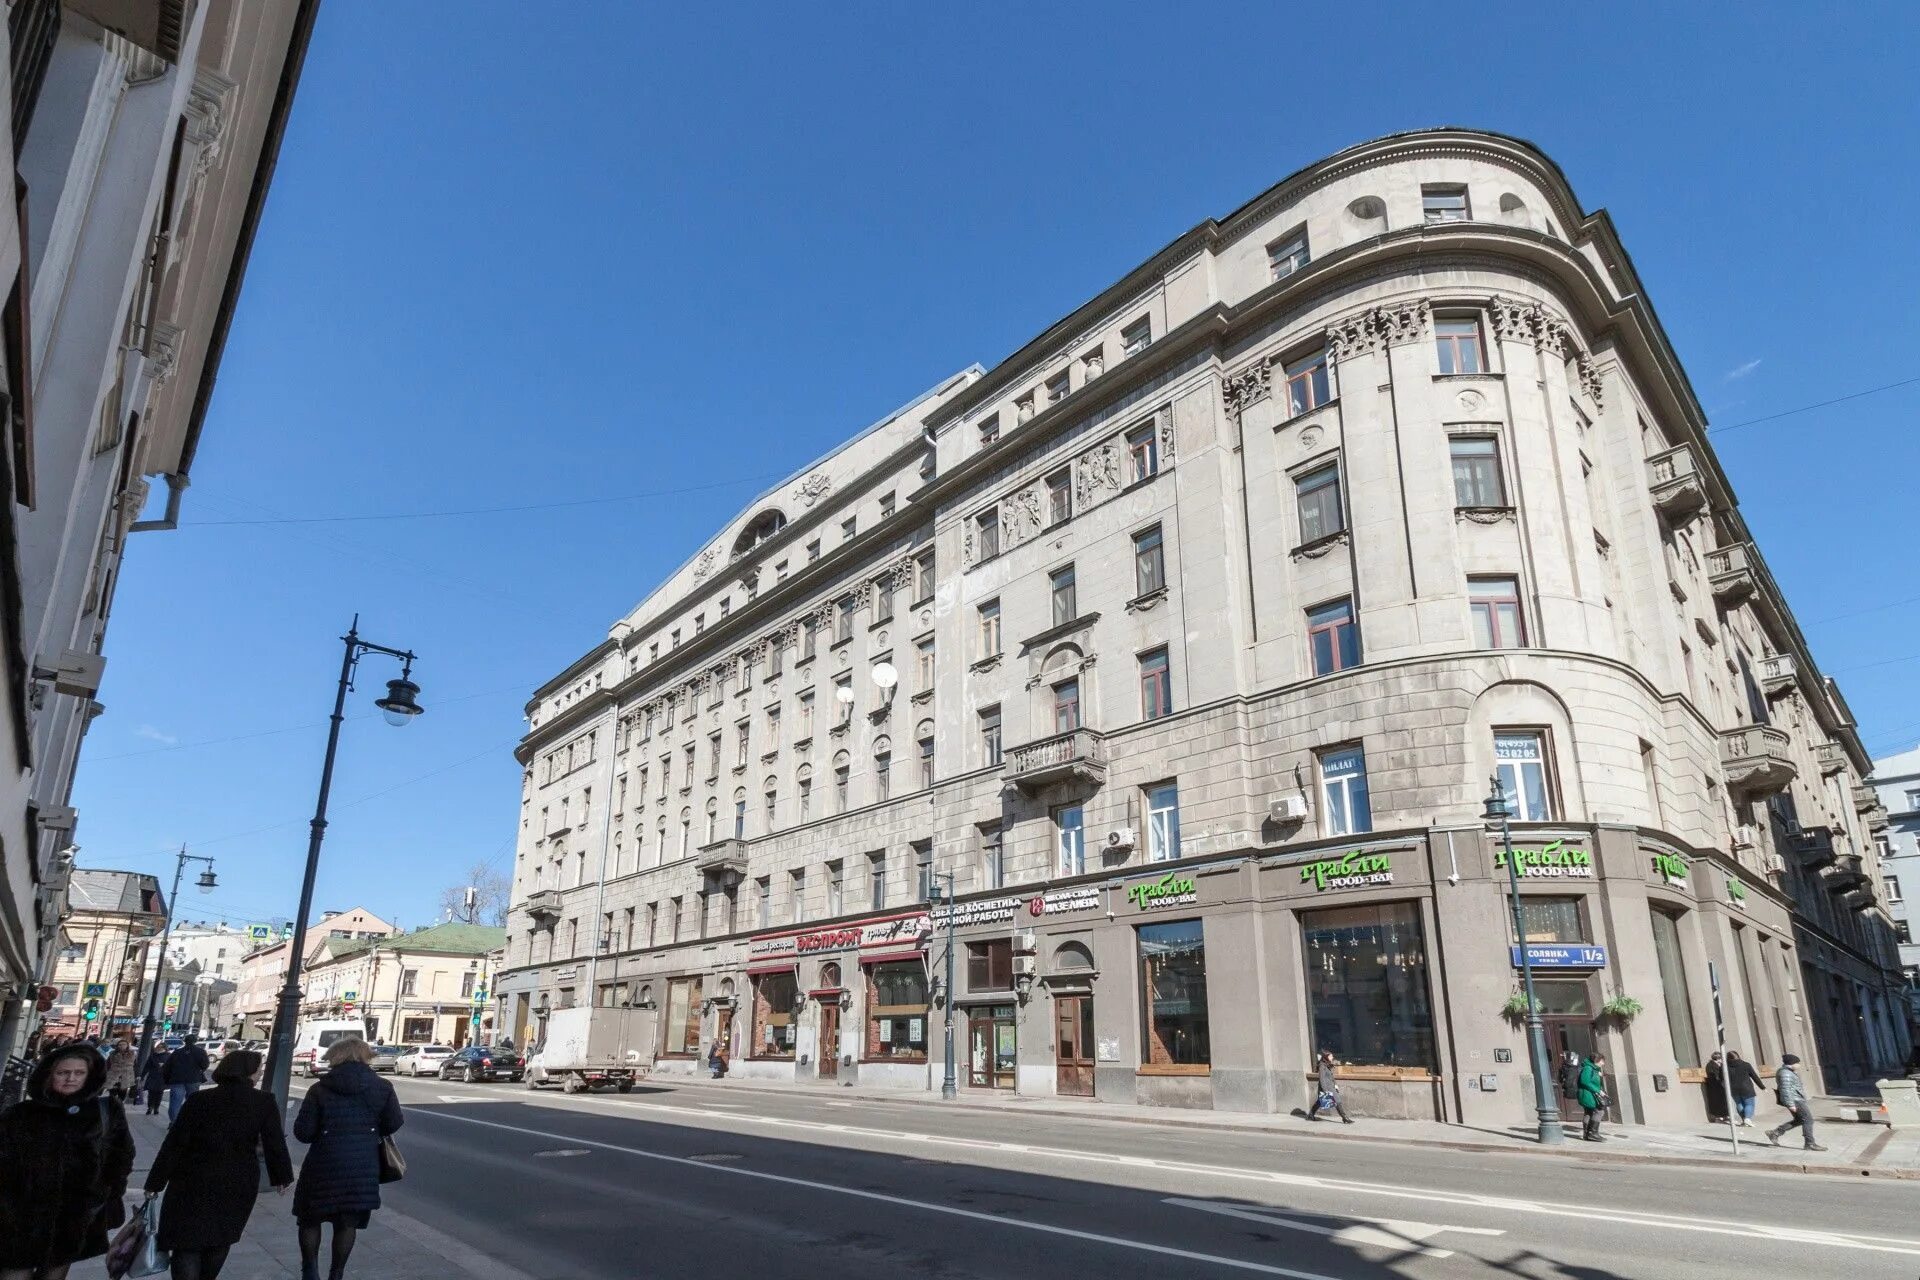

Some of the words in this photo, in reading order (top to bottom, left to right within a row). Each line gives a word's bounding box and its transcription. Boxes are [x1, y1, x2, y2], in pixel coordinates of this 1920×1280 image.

[965, 898, 1022, 913] КОСМЕТИКА
[973, 908, 1014, 922] РАБОТЫ
[1527, 950, 1569, 958] СОЛЯНКА
[1583, 949, 1603, 961] 1/2
